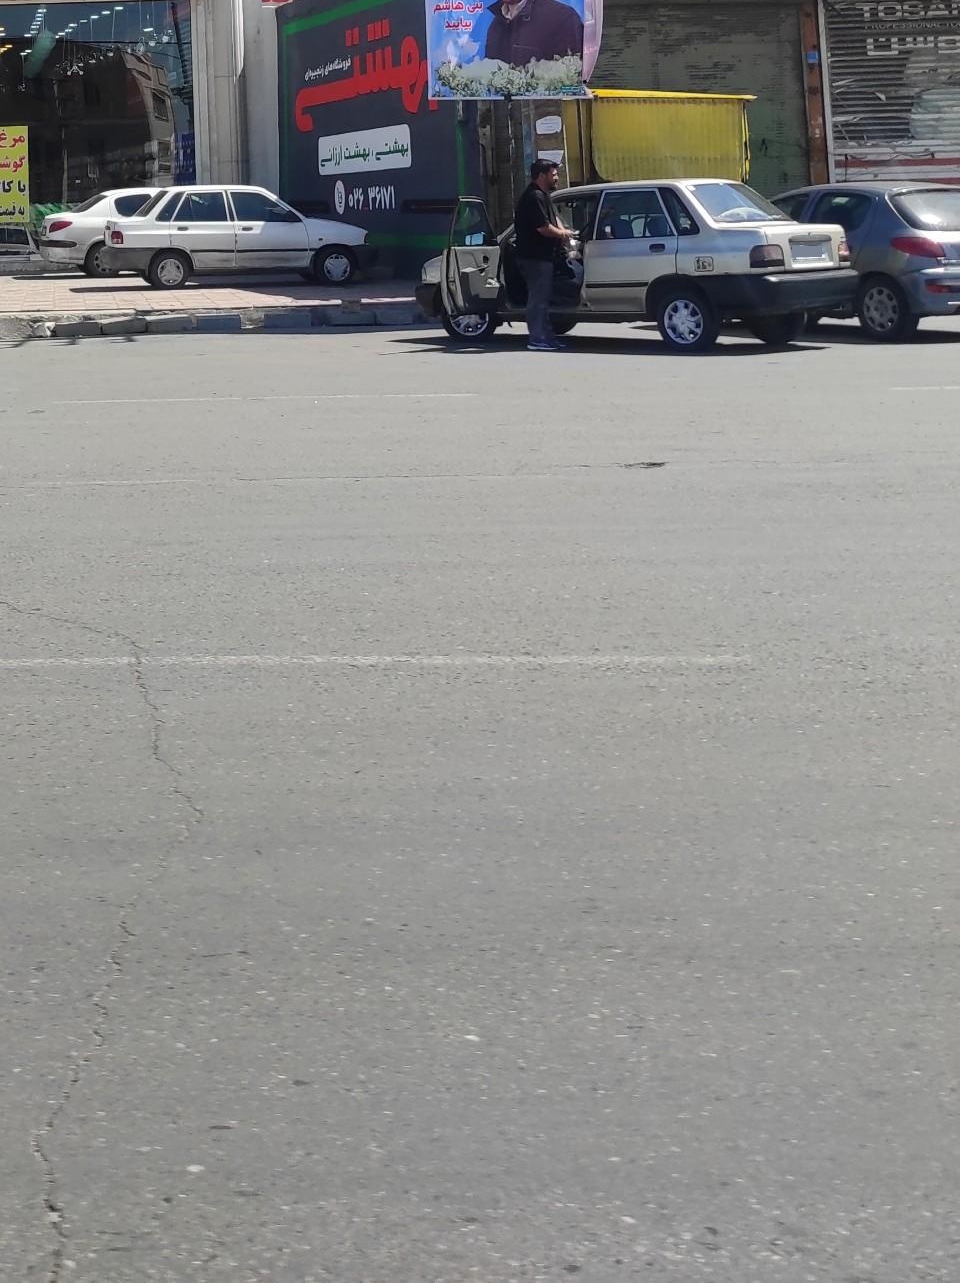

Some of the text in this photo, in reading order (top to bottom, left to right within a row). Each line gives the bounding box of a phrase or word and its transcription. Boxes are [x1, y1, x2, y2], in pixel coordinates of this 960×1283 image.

[467, 0, 484, 14] بنی
[444, 17, 473, 31] بیایید
[320, 145, 343, 167] ارزانی
[344, 142, 370, 162] بهشت
[17, 180, 26, 197] با
[18, 205, 25, 220] به
